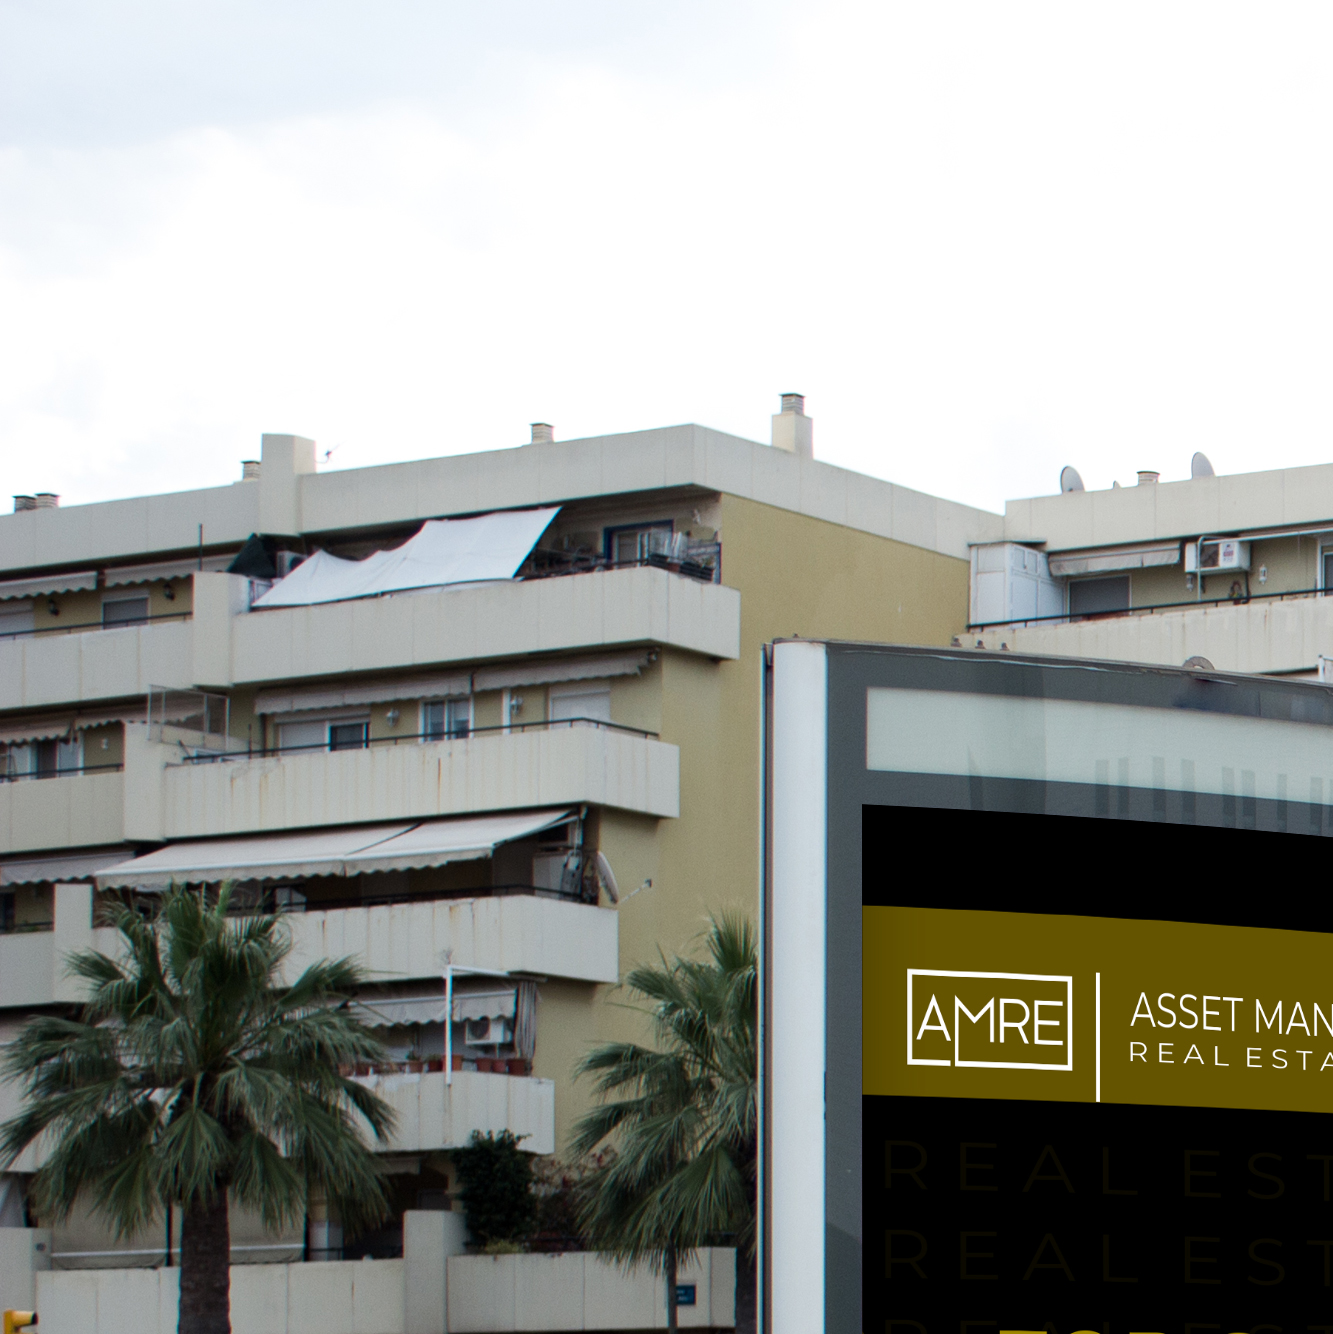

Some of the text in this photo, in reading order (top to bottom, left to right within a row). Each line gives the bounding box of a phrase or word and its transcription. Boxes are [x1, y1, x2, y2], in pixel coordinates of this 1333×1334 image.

[917, 993, 1064, 1061] AMRE
[1130, 991, 1244, 1033] ASSET
[1129, 1041, 1230, 1067] REAL
[883, 1140, 1139, 1196] REAL
[883, 1229, 1139, 1284] REAL
